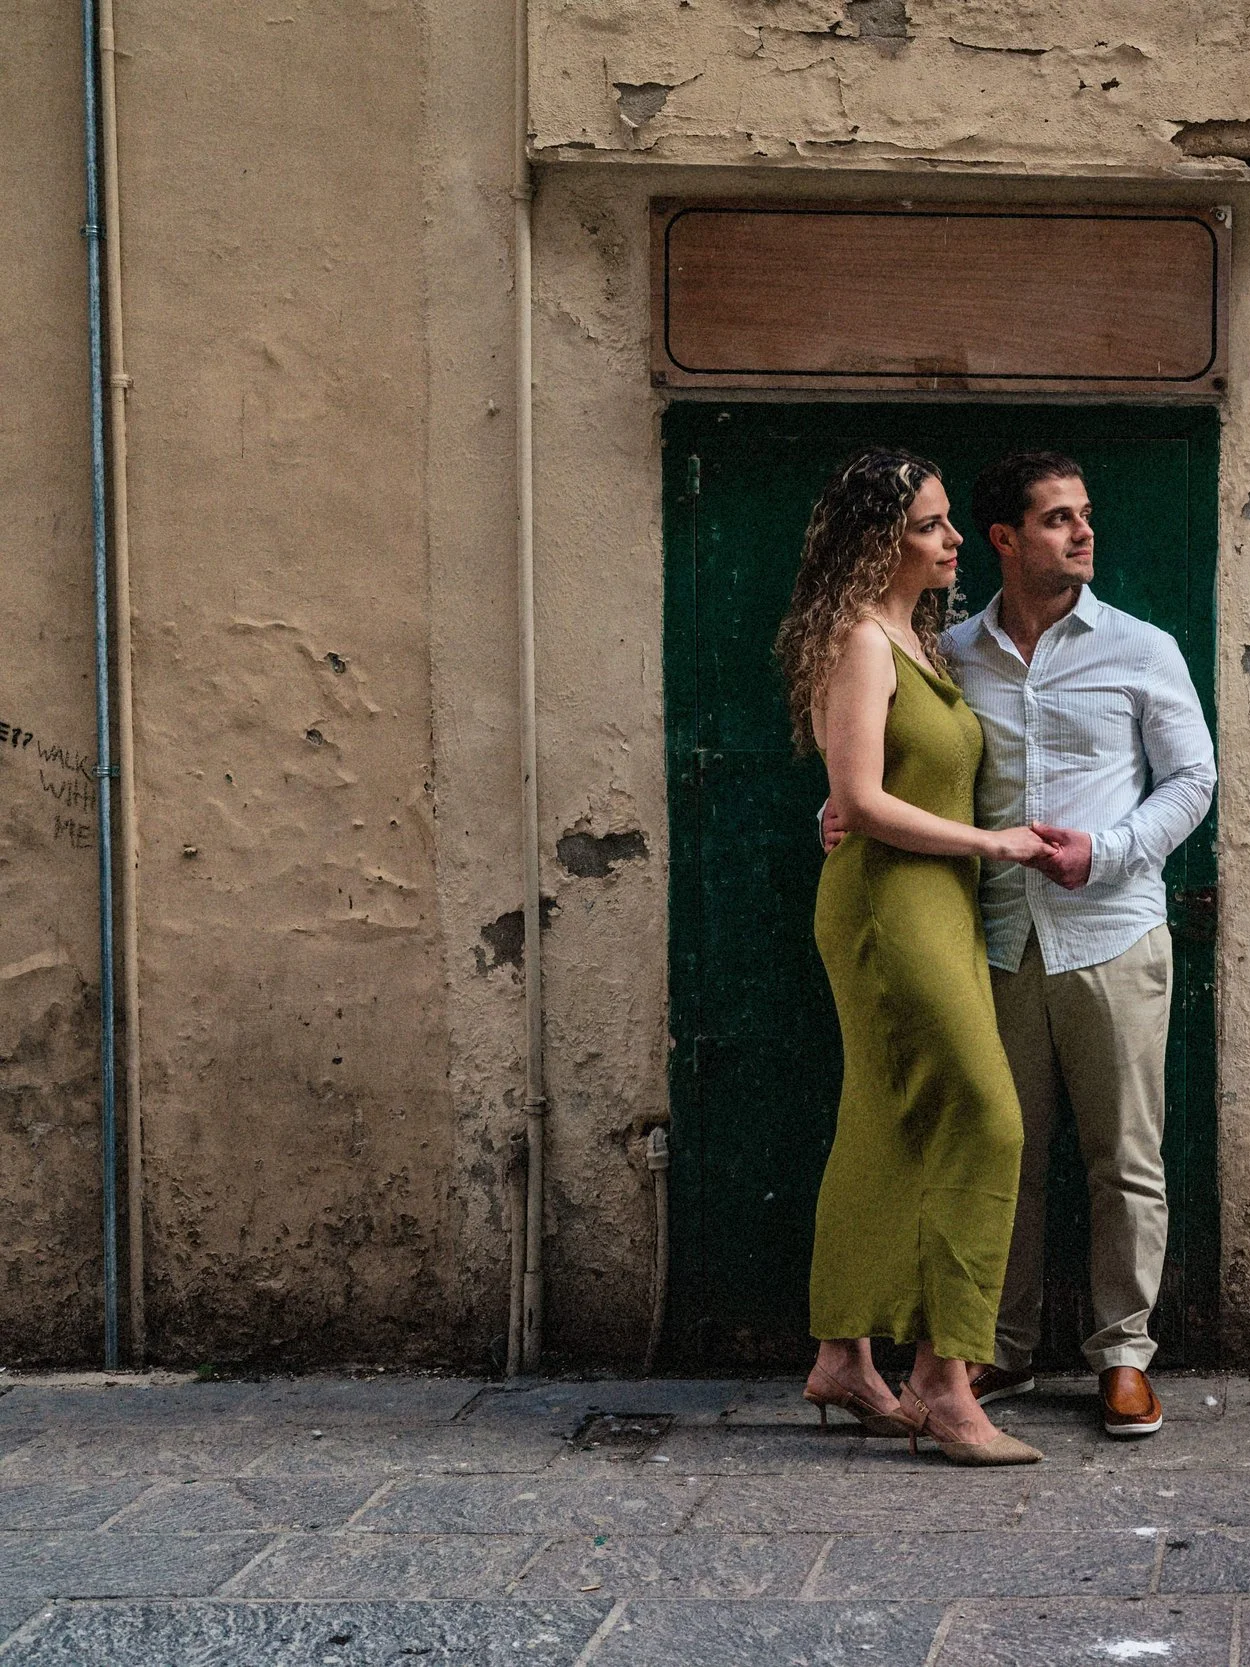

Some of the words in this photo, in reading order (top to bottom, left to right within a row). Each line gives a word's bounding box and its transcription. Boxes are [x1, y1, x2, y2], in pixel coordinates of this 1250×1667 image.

[37, 740, 92, 780] WALK
[39, 769, 96, 813] WITH
[54, 814, 93, 848] ME
